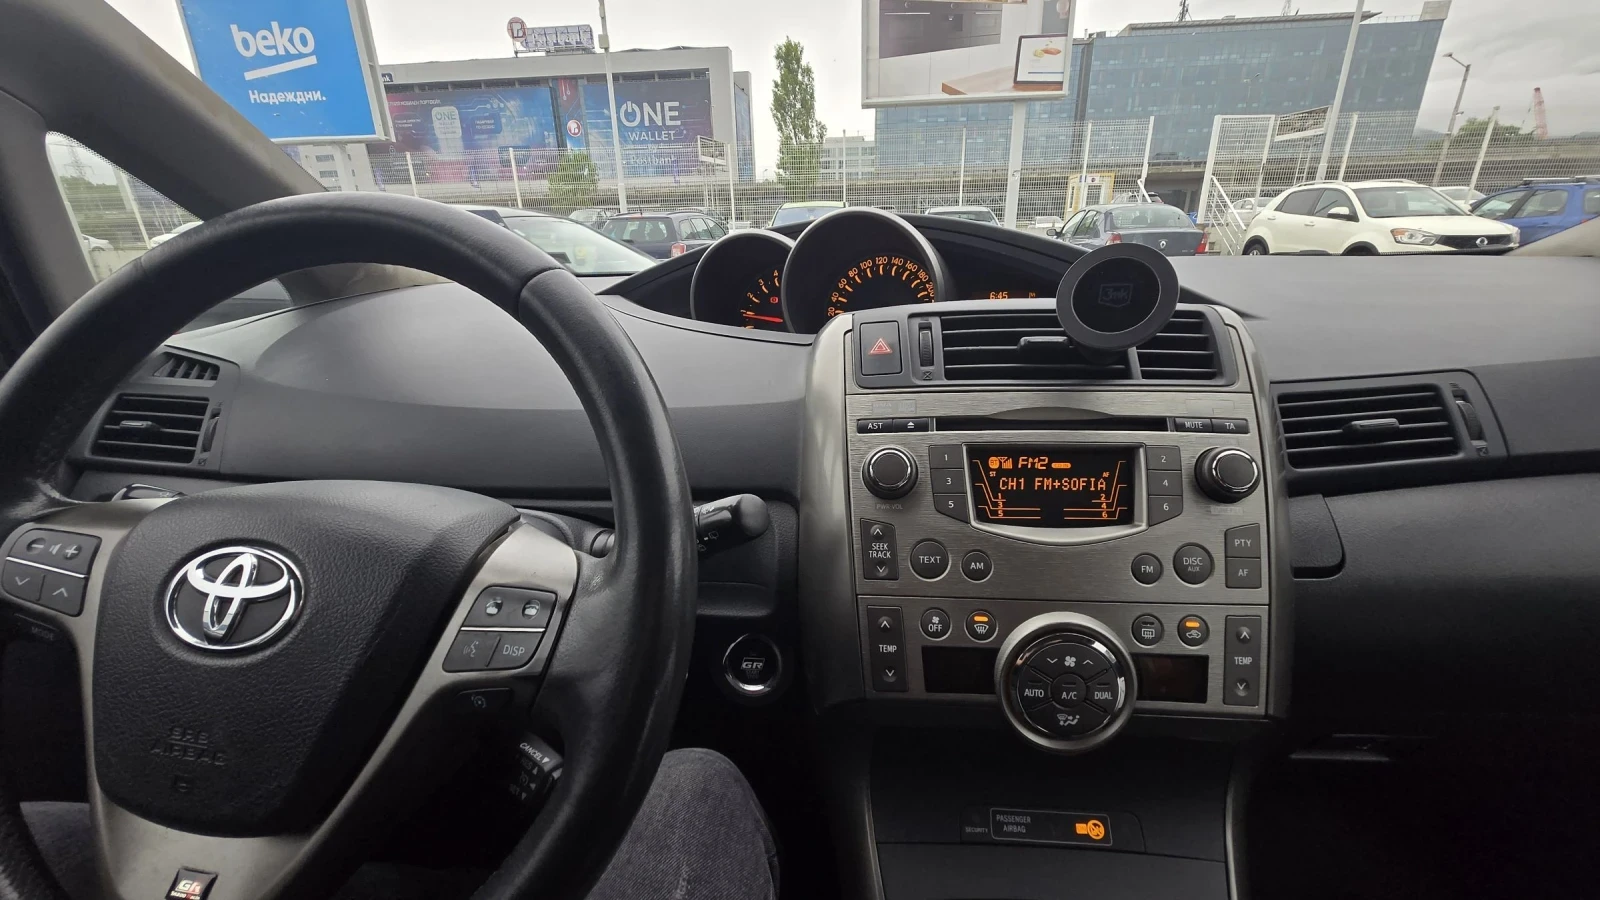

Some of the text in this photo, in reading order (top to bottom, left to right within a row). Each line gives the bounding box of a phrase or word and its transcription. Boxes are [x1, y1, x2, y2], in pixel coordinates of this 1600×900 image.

[230, 21, 315, 57] beko
[249, 89, 326, 104] Надеждни.
[435, 111, 457, 121] ONE
[620, 101, 681, 127] ONE
[628, 131, 676, 141] WALLET
[859, 259, 873, 270] 100
[875, 256, 888, 265] 120
[891, 257, 904, 266] 140
[905, 260, 918, 272] 160
[848, 268, 859, 278] 80
[917, 269, 929, 282] 180
[758, 278, 764, 286] 3
[838, 278, 848, 289] 60
[925, 282, 935, 297] 200
[831, 291, 839, 302] 40
[989, 291, 1008, 300] 6:45
[828, 306, 835, 316] 20
[1184, 421, 1203, 429] MUTE
[1018, 457, 1048, 469] FM2
[1161, 455, 1166, 463] 2
[946, 477, 952, 485] 3
[1000, 478, 1106, 491] CH1 FM+SOFIA
[1162, 479, 1168, 487] 4
[1163, 503, 1169, 511] 6
[1234, 539, 1251, 547] PTY
[869, 551, 891, 559] TRACK
[919, 556, 941, 564] TEXT
[1183, 557, 1203, 565] DISC
[970, 562, 984, 570] AM
[1141, 565, 1154, 573] FM
[1238, 569, 1249, 577] AF
[928, 624, 943, 632] OFF
[502, 644, 525, 657] DISP
[879, 645, 897, 653] TEMP
[742, 661, 763, 669] GR
[1234, 656, 1253, 665] TEMP
[1024, 689, 1113, 700] AUTO A/C DUAL
[519, 742, 544, 761] CANCEL
[996, 814, 1031, 823] PASSENGER
[1003, 824, 1026, 833] AIRBAG
[176, 879, 201, 893] GR
